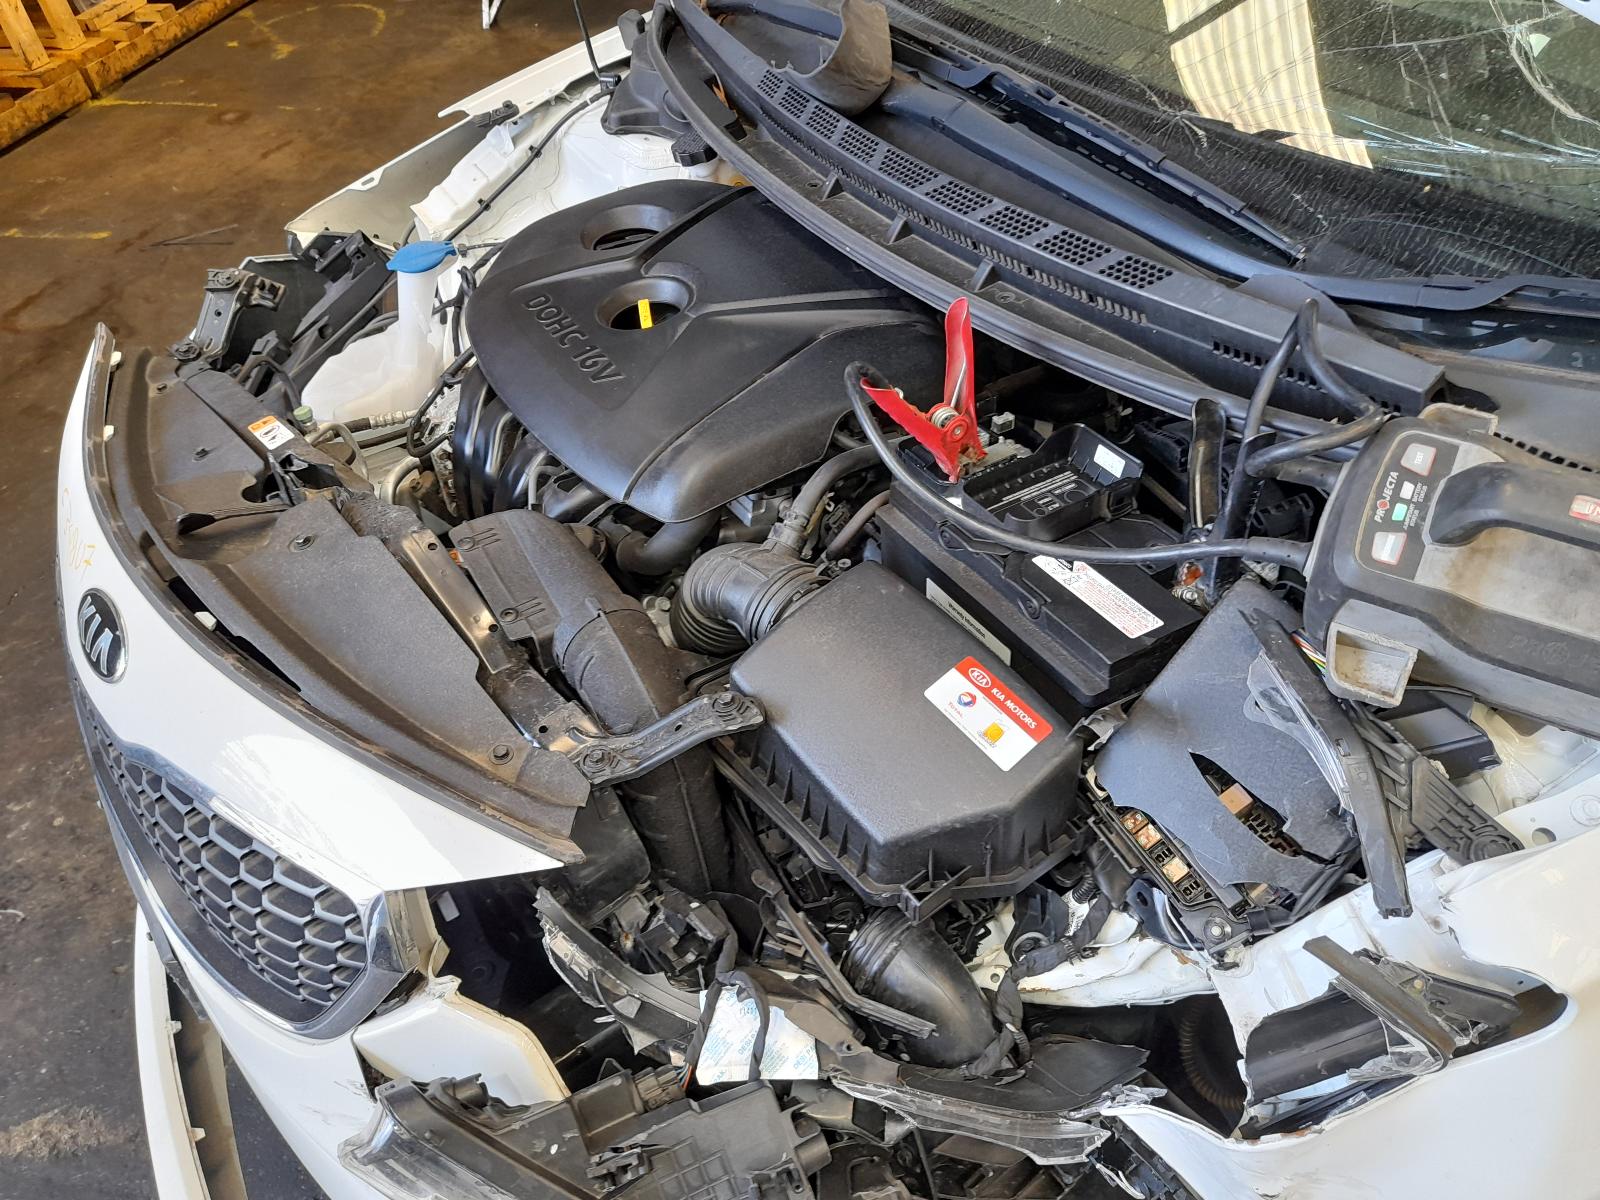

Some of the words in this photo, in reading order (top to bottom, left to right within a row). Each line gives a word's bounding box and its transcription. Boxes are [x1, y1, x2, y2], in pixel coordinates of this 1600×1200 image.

[522, 293, 588, 348] DOHC
[571, 344, 626, 384] 16V
[1374, 471, 1399, 523] PROJECTA
[79, 595, 114, 675] KIA
[971, 669, 988, 687] KIA
[990, 687, 1005, 703] KIA
[1005, 699, 1038, 730] MOTORS
